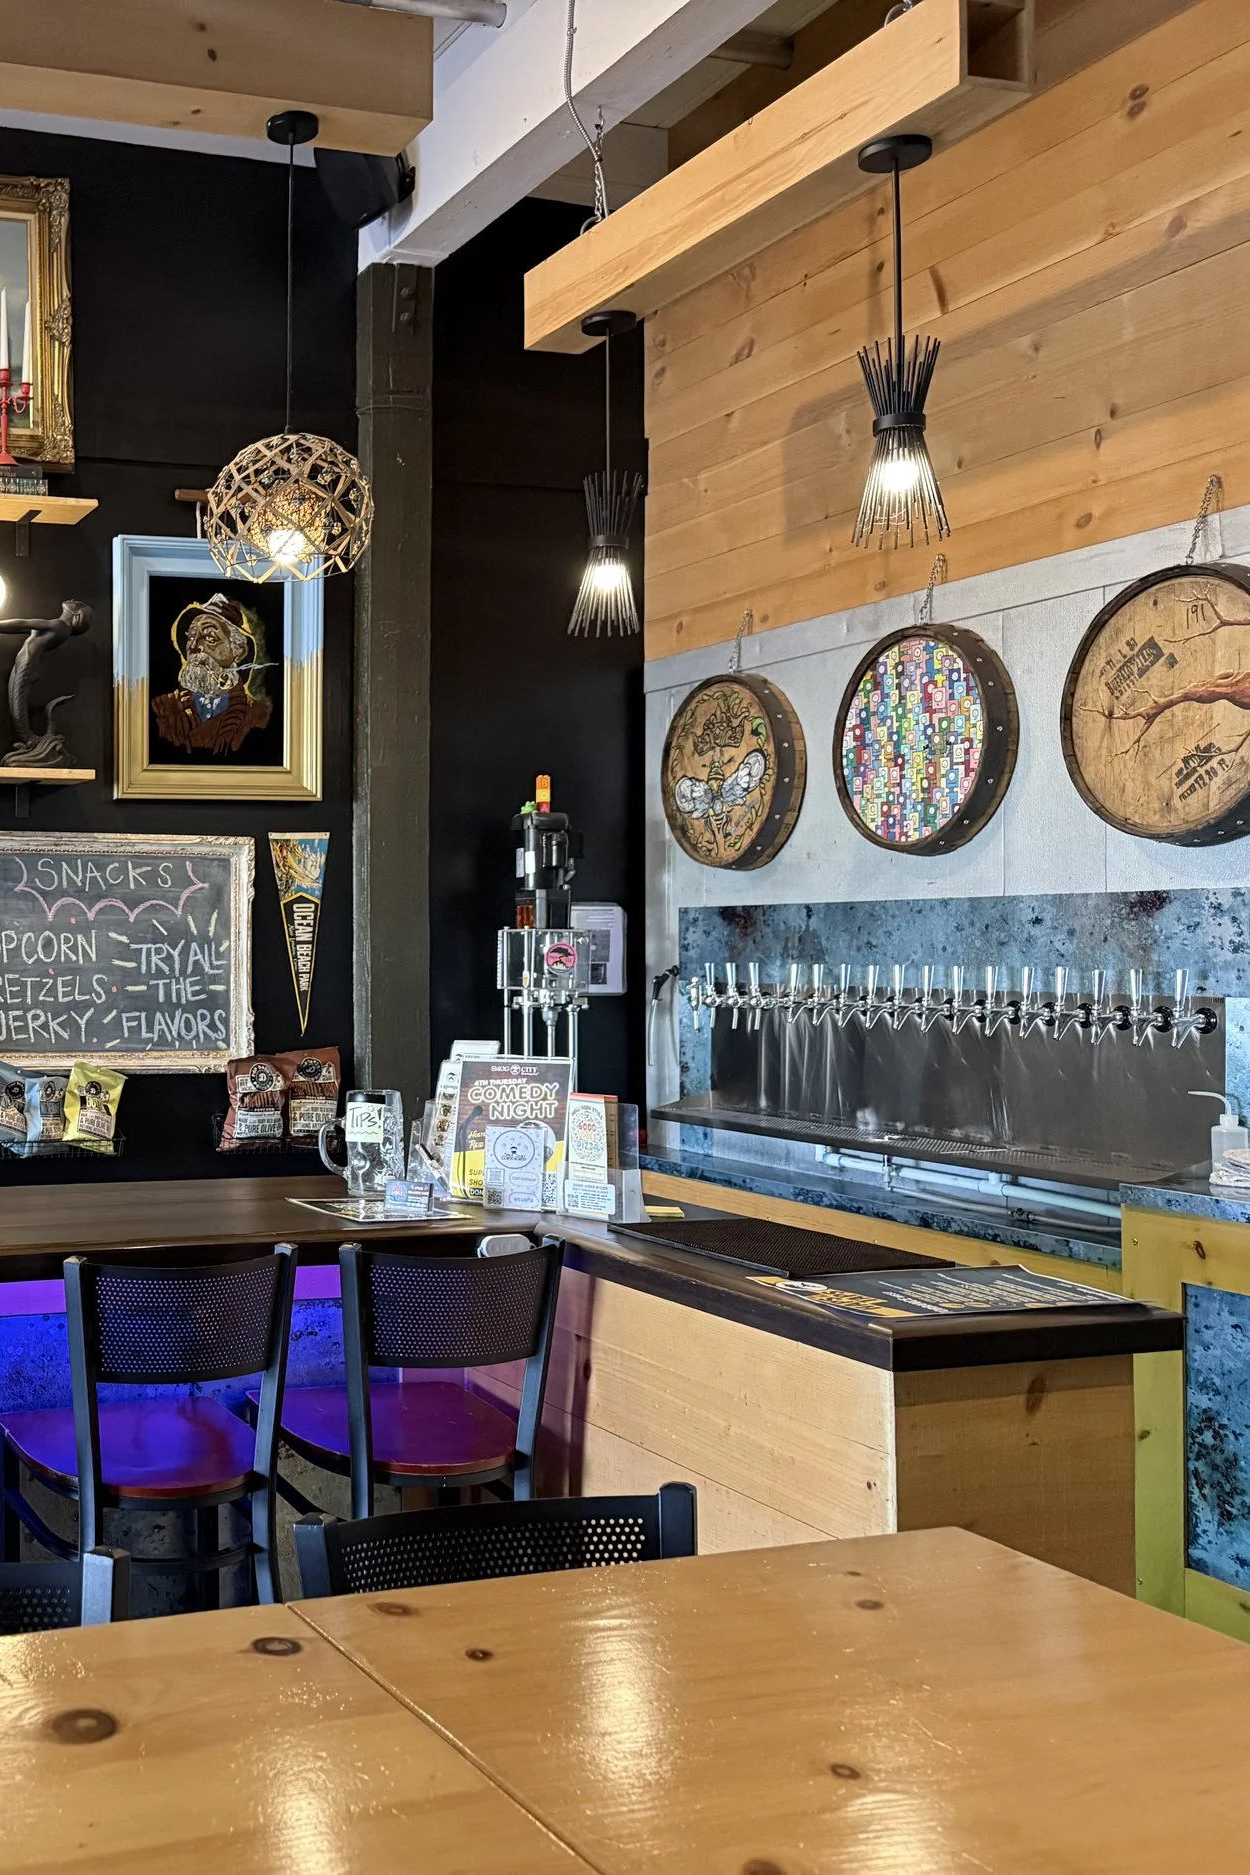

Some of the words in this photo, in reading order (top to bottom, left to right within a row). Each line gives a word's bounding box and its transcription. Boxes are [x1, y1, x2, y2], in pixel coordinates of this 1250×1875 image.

[1186, 604, 1206, 630] 191
[35, 857, 173, 891] SNACKS
[293, 903, 315, 942] OCEAN
[130, 939, 184, 977] TRY
[186, 941, 228, 974] ALL
[296, 944, 312, 973] BEACH
[149, 976, 208, 1004] THE
[299, 973, 310, 992] PARK
[122, 1008, 226, 1043] FLAVORS
[468, 1082, 559, 1104] COMEDY
[299, 1112, 314, 1121] PURE
[490, 1100, 558, 1120] NIGHT
[245, 1125, 261, 1134] PURE
